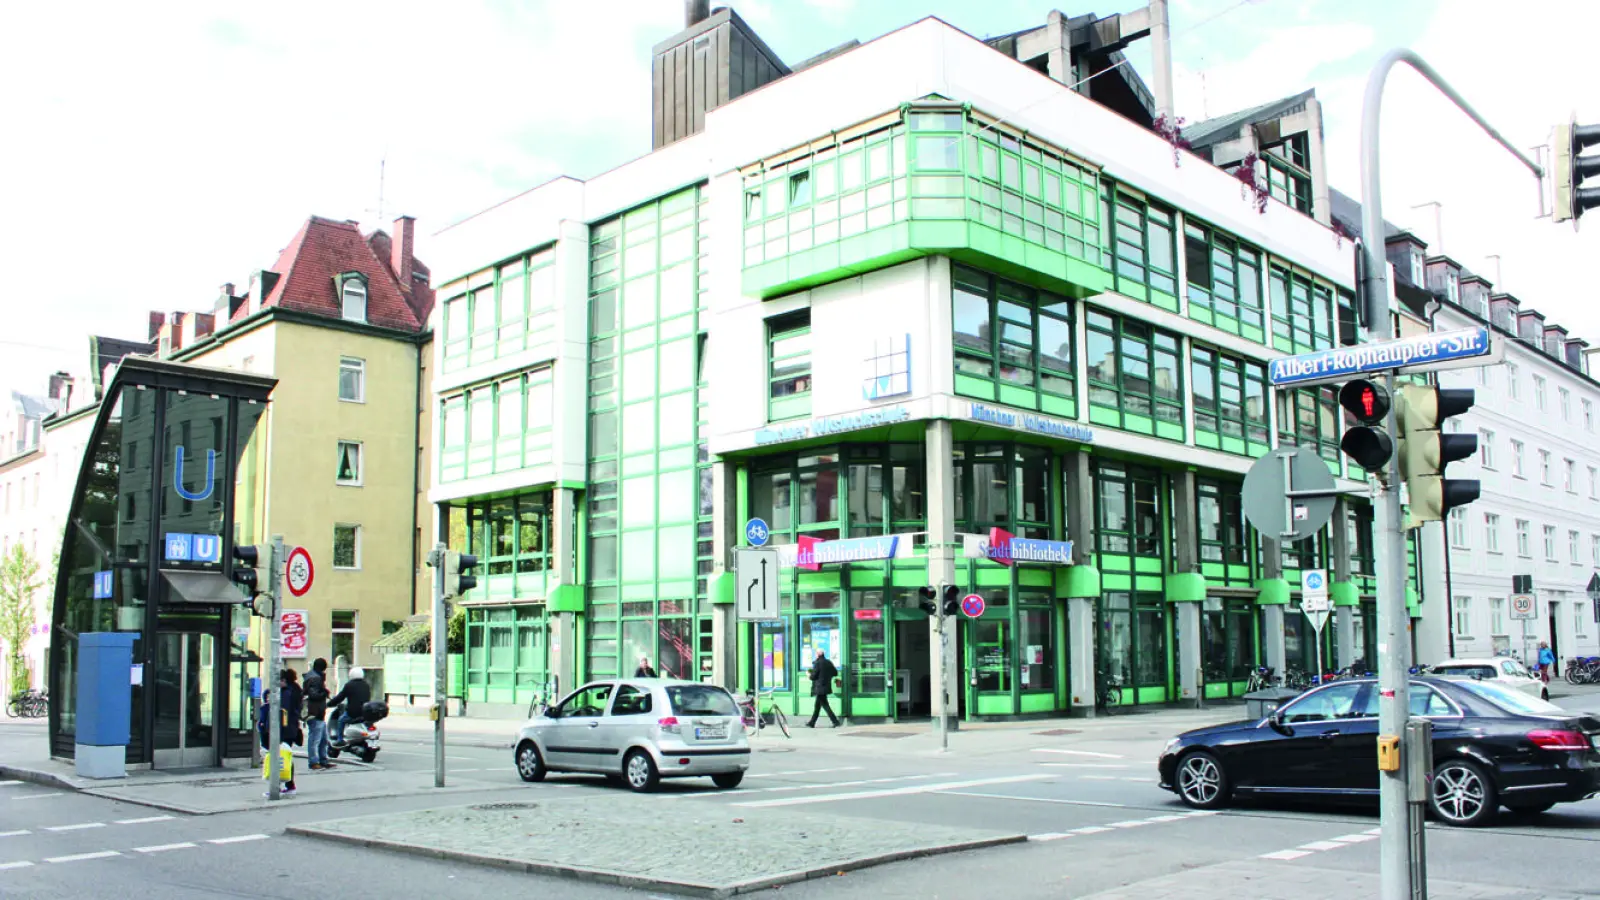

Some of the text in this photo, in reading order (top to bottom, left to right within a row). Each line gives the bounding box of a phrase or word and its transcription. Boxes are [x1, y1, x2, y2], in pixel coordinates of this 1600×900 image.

[174, 446, 215, 500] U
[197, 538, 213, 557] U
[978, 540, 1068, 562] Stadtbibliothek
[103, 574, 112, 594] U
[1517, 599, 1529, 609] 30
